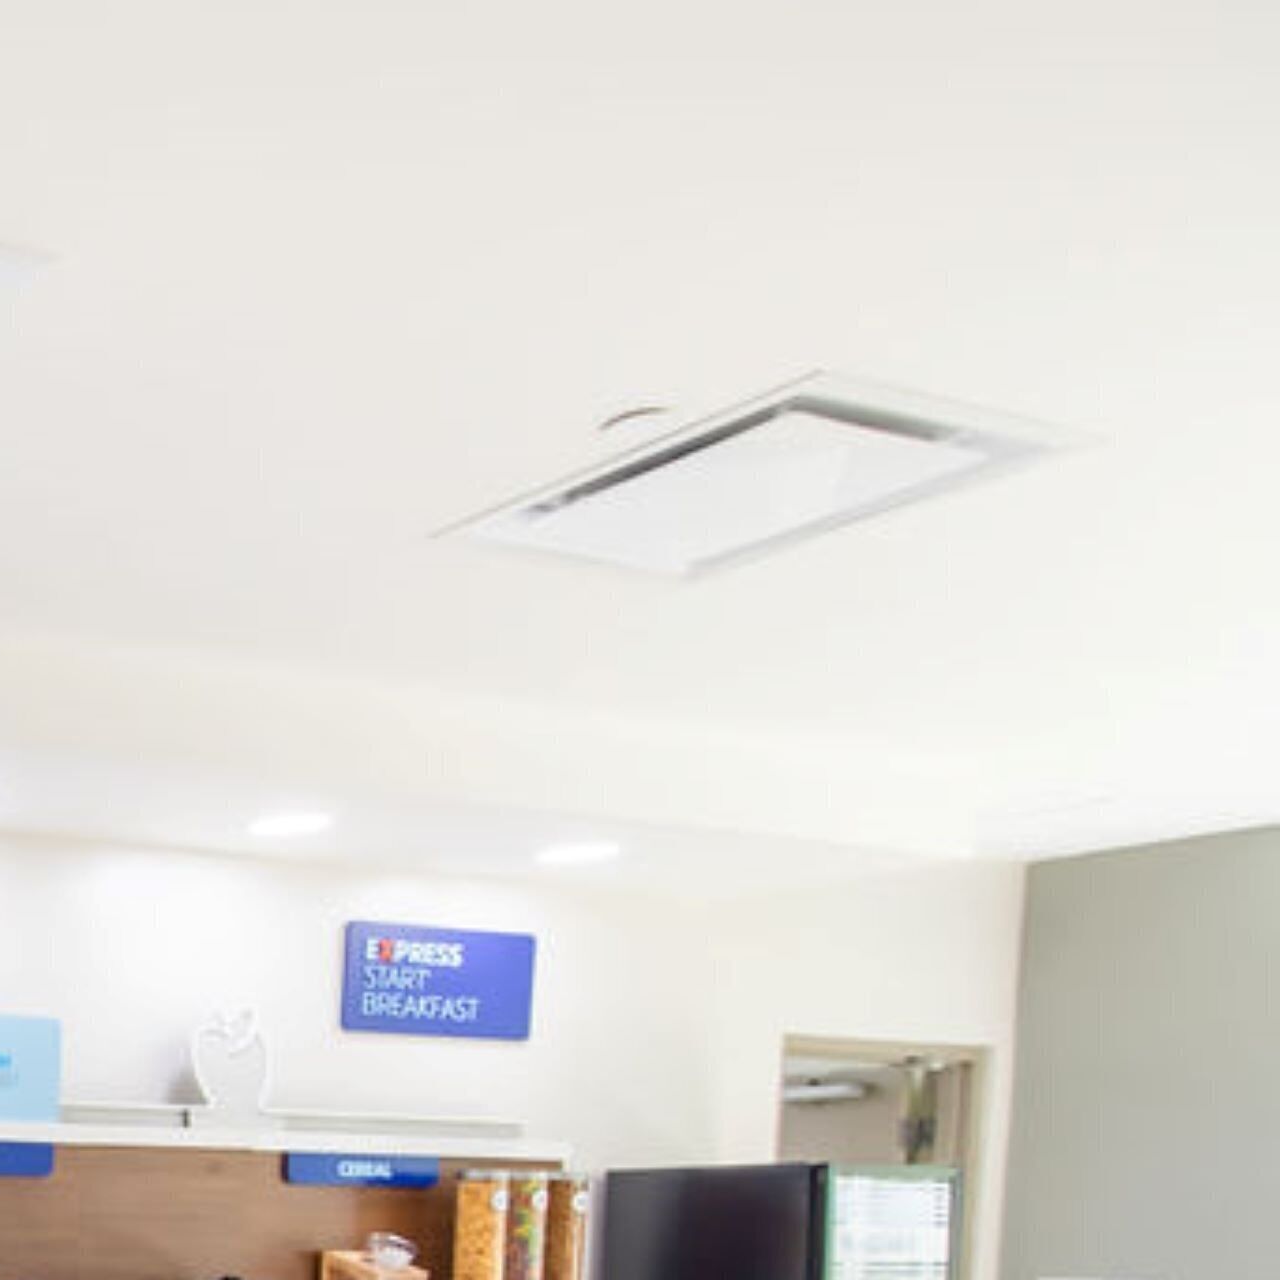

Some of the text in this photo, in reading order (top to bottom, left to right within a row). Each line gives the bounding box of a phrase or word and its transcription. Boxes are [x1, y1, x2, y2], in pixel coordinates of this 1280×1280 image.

[365, 938, 464, 968] EXPRESS
[362, 965, 431, 990] START
[362, 991, 480, 1022] BREAKFAST
